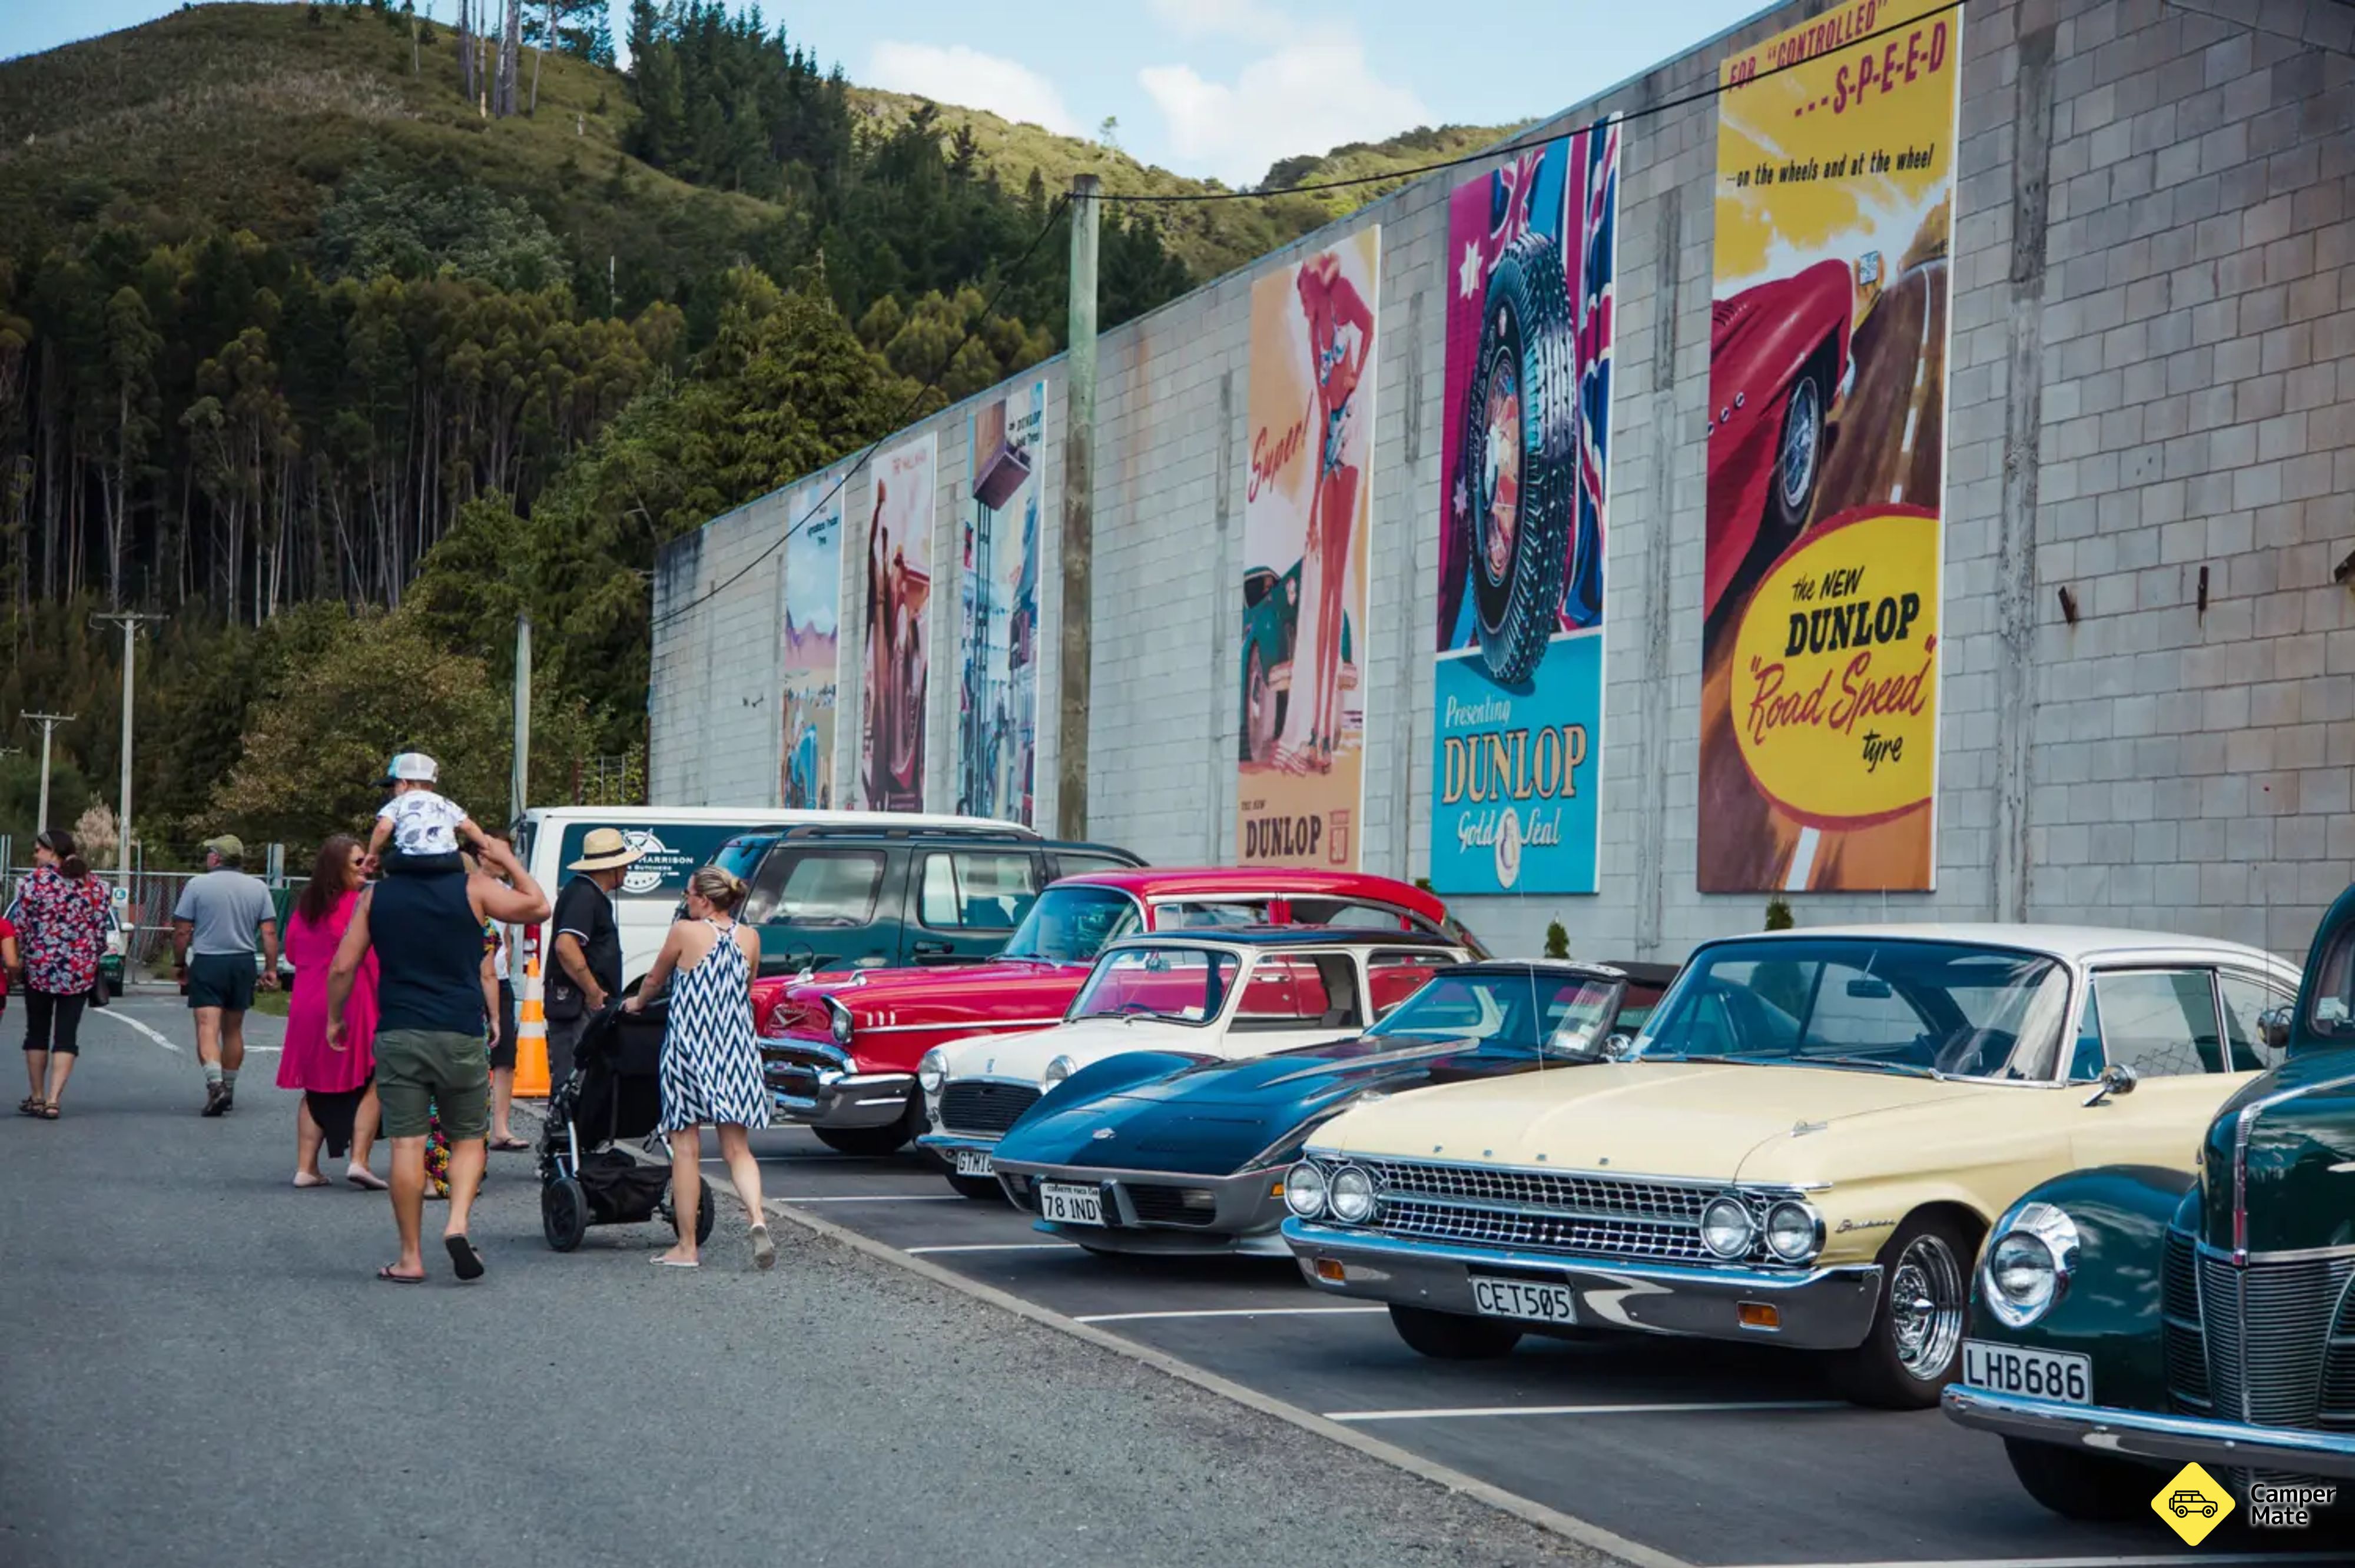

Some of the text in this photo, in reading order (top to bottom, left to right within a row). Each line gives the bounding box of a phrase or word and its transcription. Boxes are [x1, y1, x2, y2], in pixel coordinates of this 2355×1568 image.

[1729, 56, 1756, 92] FOR
[1754, 163, 1773, 185] the
[1779, 157, 1818, 182] wheels
[1825, 152, 1846, 178] and
[1850, 153, 1865, 177] at
[1870, 149, 1890, 174] the
[1896, 143, 1935, 170] wheel
[1792, 565, 1865, 602] the NEW
[1784, 592, 1920, 657] DUNLOP
[1444, 693, 1511, 728] Presenting
[1441, 723, 1587, 806] DUNLOP
[1862, 728, 1903, 773] tyre
[1245, 815, 1322, 859] DUNLOP
[1457, 807, 1561, 854] Gold Seal
[638, 856, 694, 864] HARRISON
[1044, 1195, 1065, 1218] 78
[1477, 1283, 1570, 1318] CET505
[1967, 1349, 2085, 1400] LHB686
